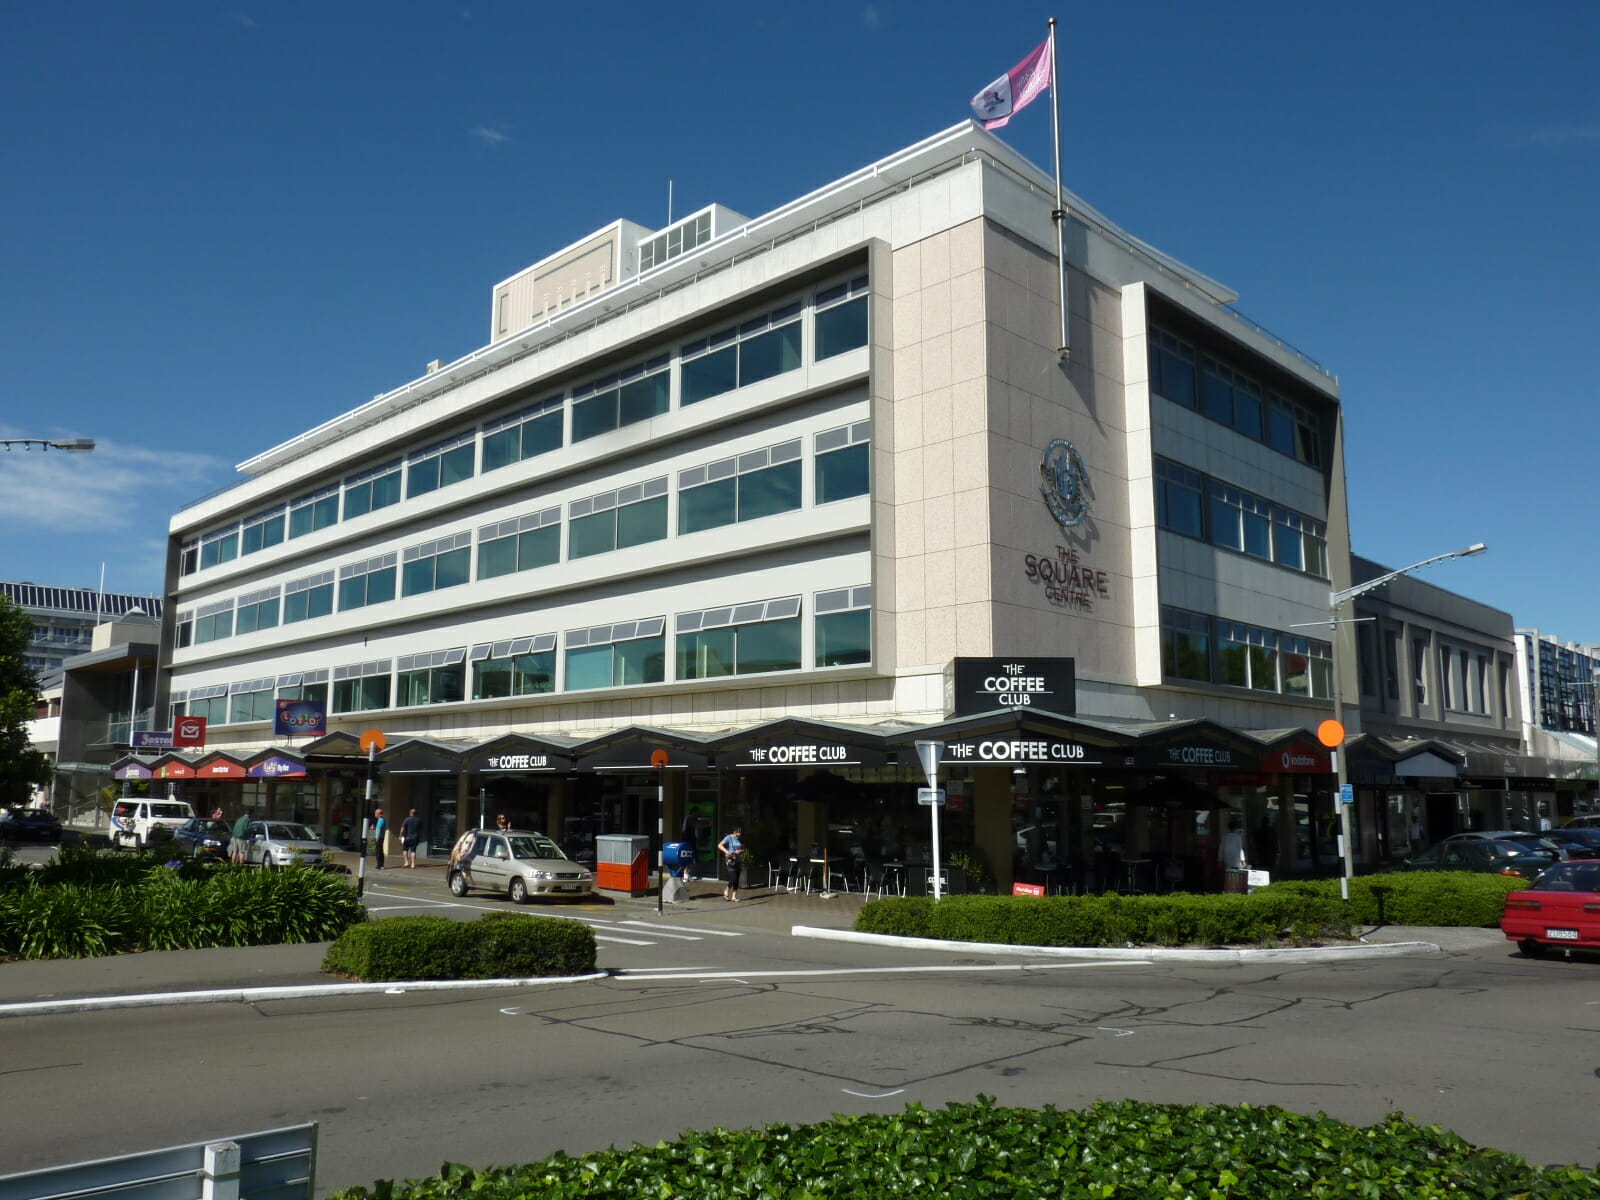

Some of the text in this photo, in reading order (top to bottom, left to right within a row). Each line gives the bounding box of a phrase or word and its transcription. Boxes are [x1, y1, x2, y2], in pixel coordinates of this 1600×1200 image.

[1056, 545, 1079, 562] THE
[1025, 554, 1107, 593] SQUARE
[1045, 586, 1090, 606] CENTRE
[1001, 664, 1026, 676] THE
[984, 676, 1045, 692] COFFEE
[998, 693, 1031, 706] CLUB
[749, 745, 847, 763] THE COFFEE CLUB
[947, 741, 1084, 760] THE COFFEE CLUB
[1167, 746, 1231, 763] THE COFFEE CLUB
[488, 754, 547, 769] THE COFFEE CLUB
